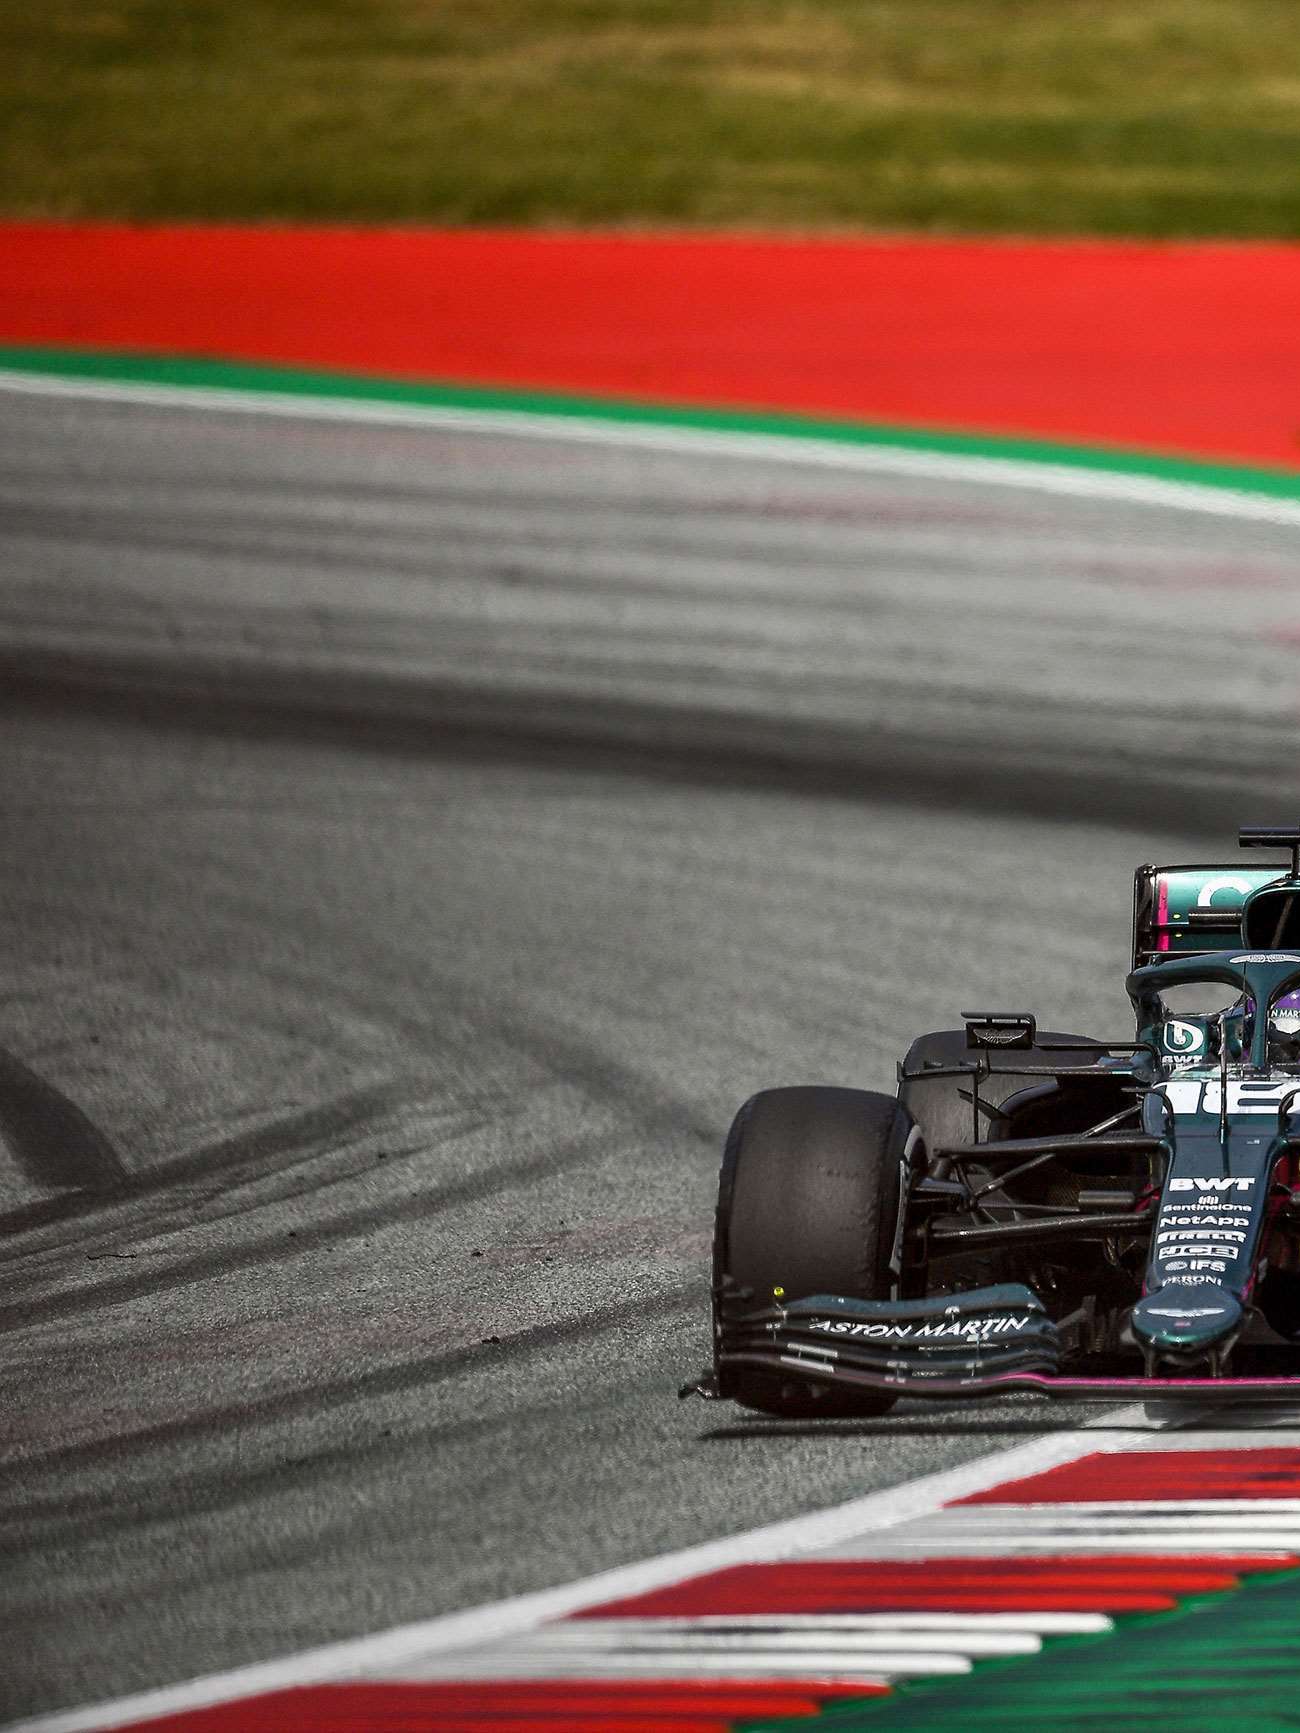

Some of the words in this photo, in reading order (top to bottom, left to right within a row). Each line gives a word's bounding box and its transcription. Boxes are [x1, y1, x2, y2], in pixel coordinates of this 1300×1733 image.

[1169, 1178, 1255, 1191] BWT
[1163, 1204, 1252, 1213] SentinelOne
[1160, 1216, 1249, 1227] NetApp
[1157, 1230, 1247, 1244] PIRELLI
[1161, 1245, 1237, 1258] JCB
[1190, 1260, 1226, 1272] IFS
[1161, 1275, 1222, 1287] PERONI
[809, 1321, 912, 1338] ASTON
[914, 1317, 1029, 1337] MARTIN
